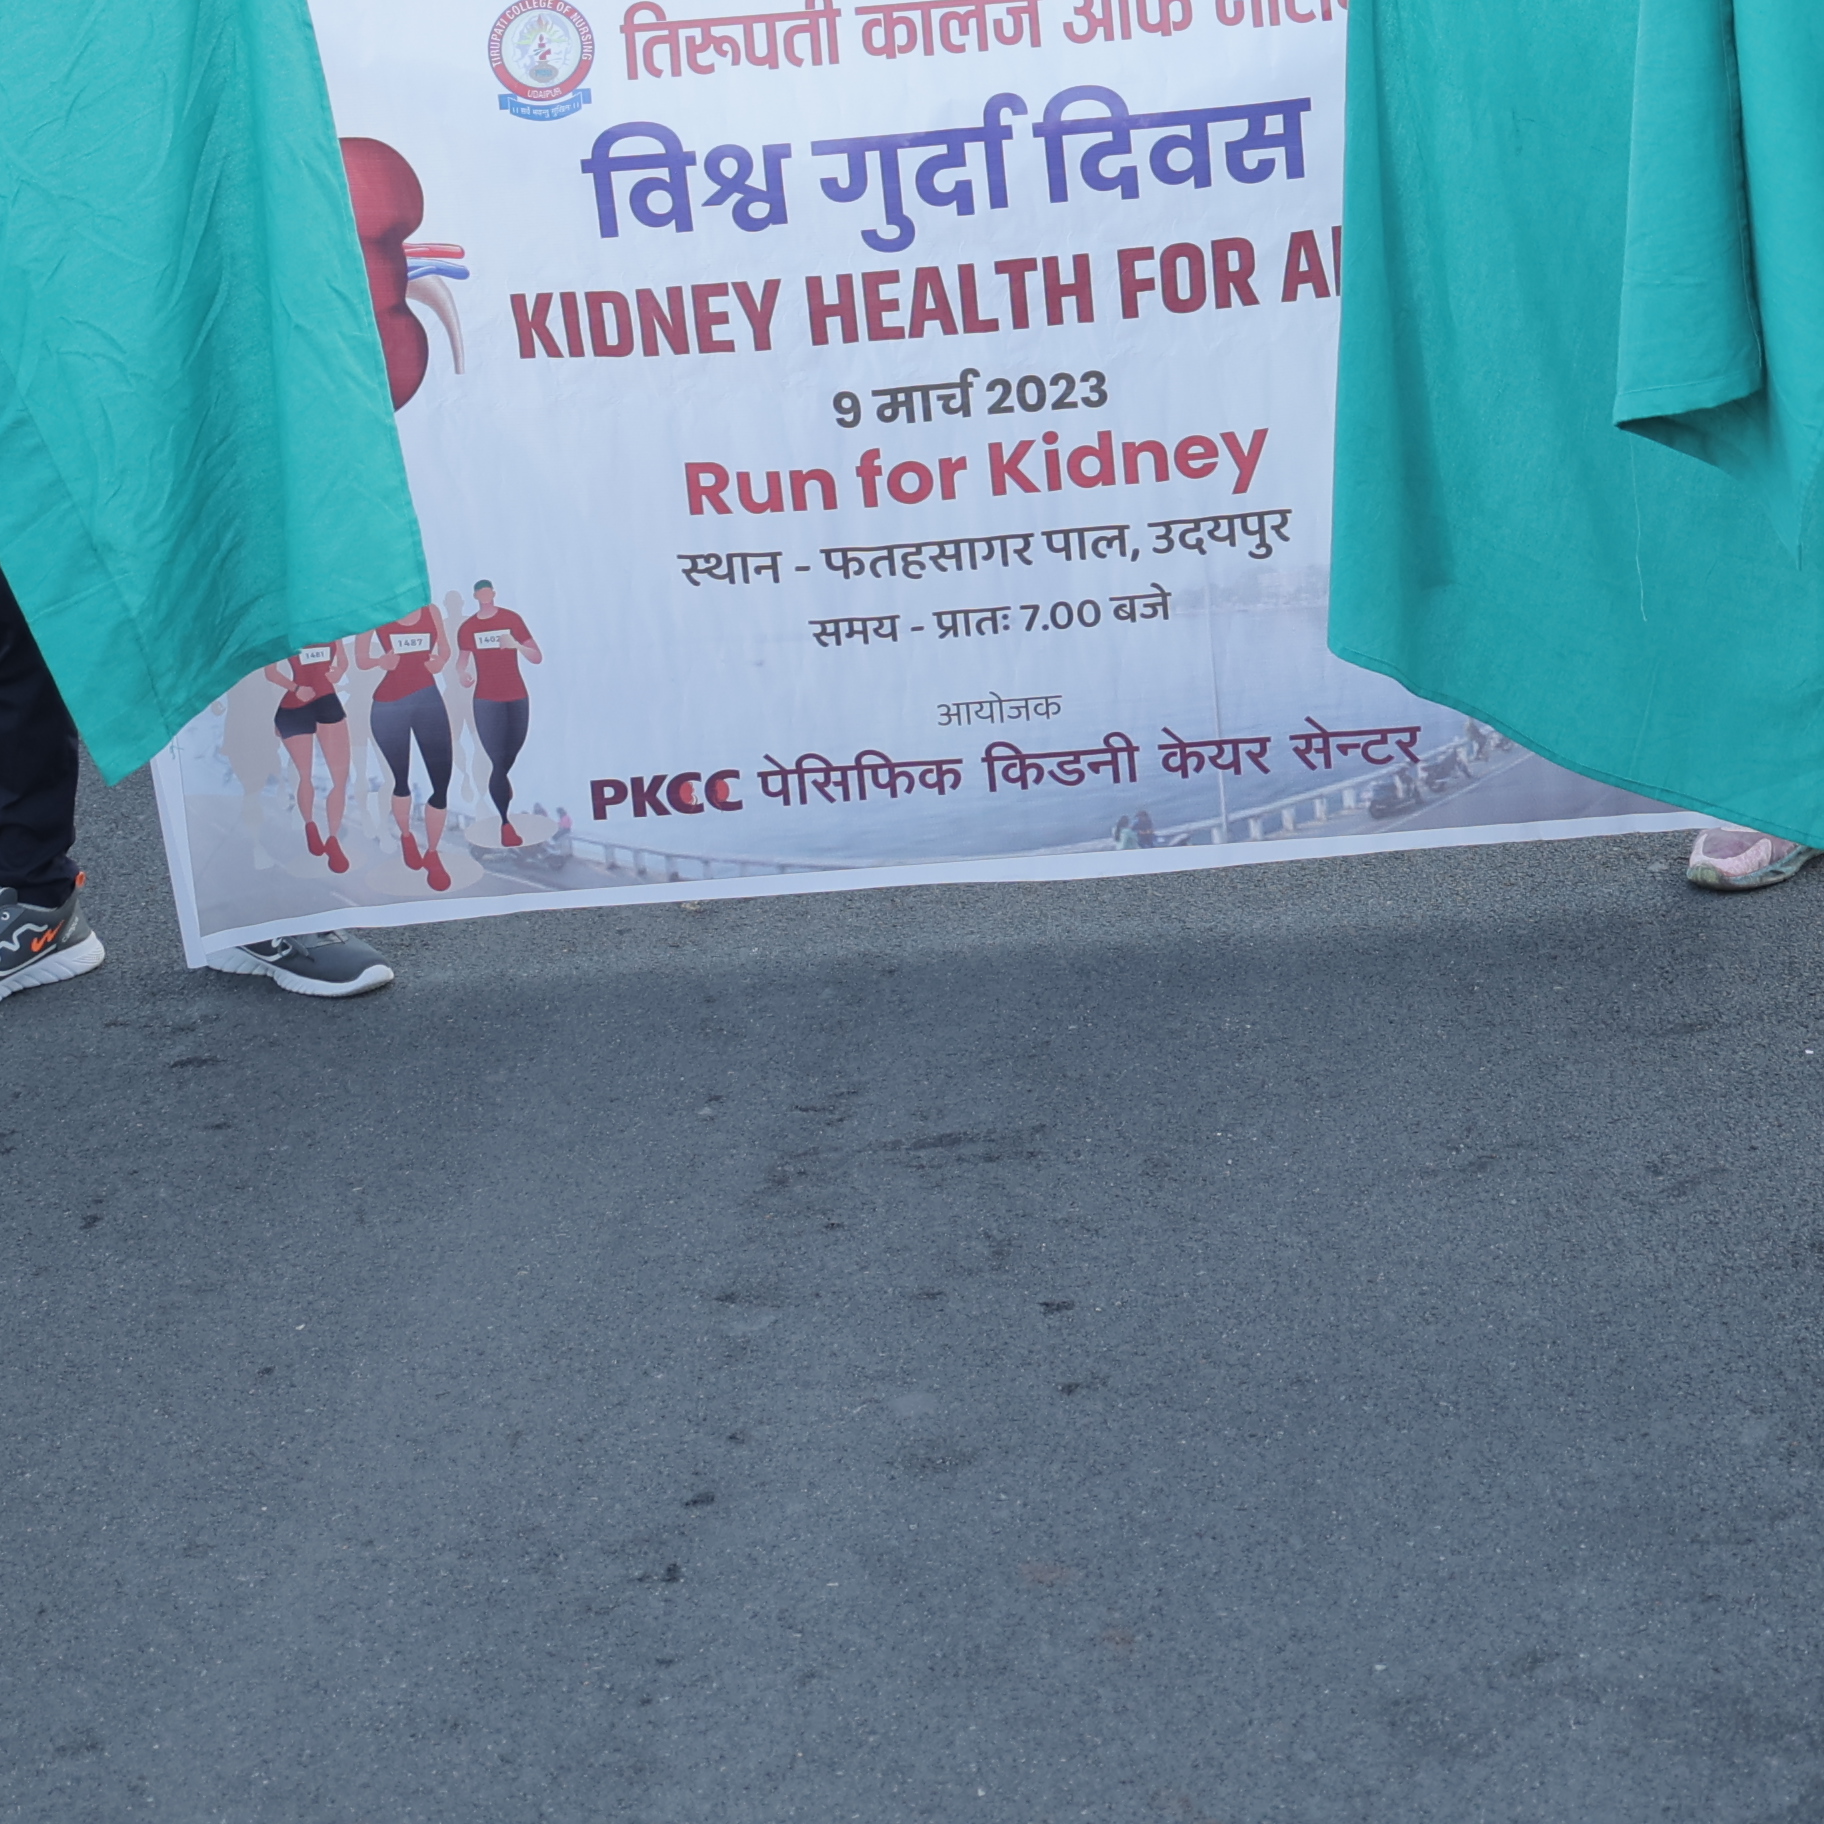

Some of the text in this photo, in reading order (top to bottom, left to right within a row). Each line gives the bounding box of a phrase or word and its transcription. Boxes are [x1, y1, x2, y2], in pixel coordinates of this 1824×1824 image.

[489, 18, 508, 68] TIRUPATI
[556, 1, 572, 14] OF
[570, 12, 593, 61] NURSING
[527, 87, 562, 99] UDAIPUR
[580, 85, 1312, 253] विश्व गुर्दा दिवस
[510, 278, 781, 359] KIDNEY
[805, 252, 1095, 346] HEALTH
[1116, 237, 1260, 319] FOR
[832, 367, 1109, 428] 9 मार्च 2023
[684, 427, 1269, 516] Run for Kidney
[677, 550, 782, 587] स्थान
[820, 533, 1035, 579] फतहसागर
[1042, 524, 1140, 562] पाल,
[1147, 508, 1293, 559] उदयपुर
[397, 637, 424, 648] 1487
[808, 614, 901, 648] समय
[933, 605, 1012, 641] प्रातः
[1020, 598, 1102, 633] 7.00
[1109, 582, 1172, 624] बजे
[937, 691, 1062, 727] आयोजक
[589, 716, 1423, 821] PKCC पेसिफिक किडनी केयर सेन्टर
